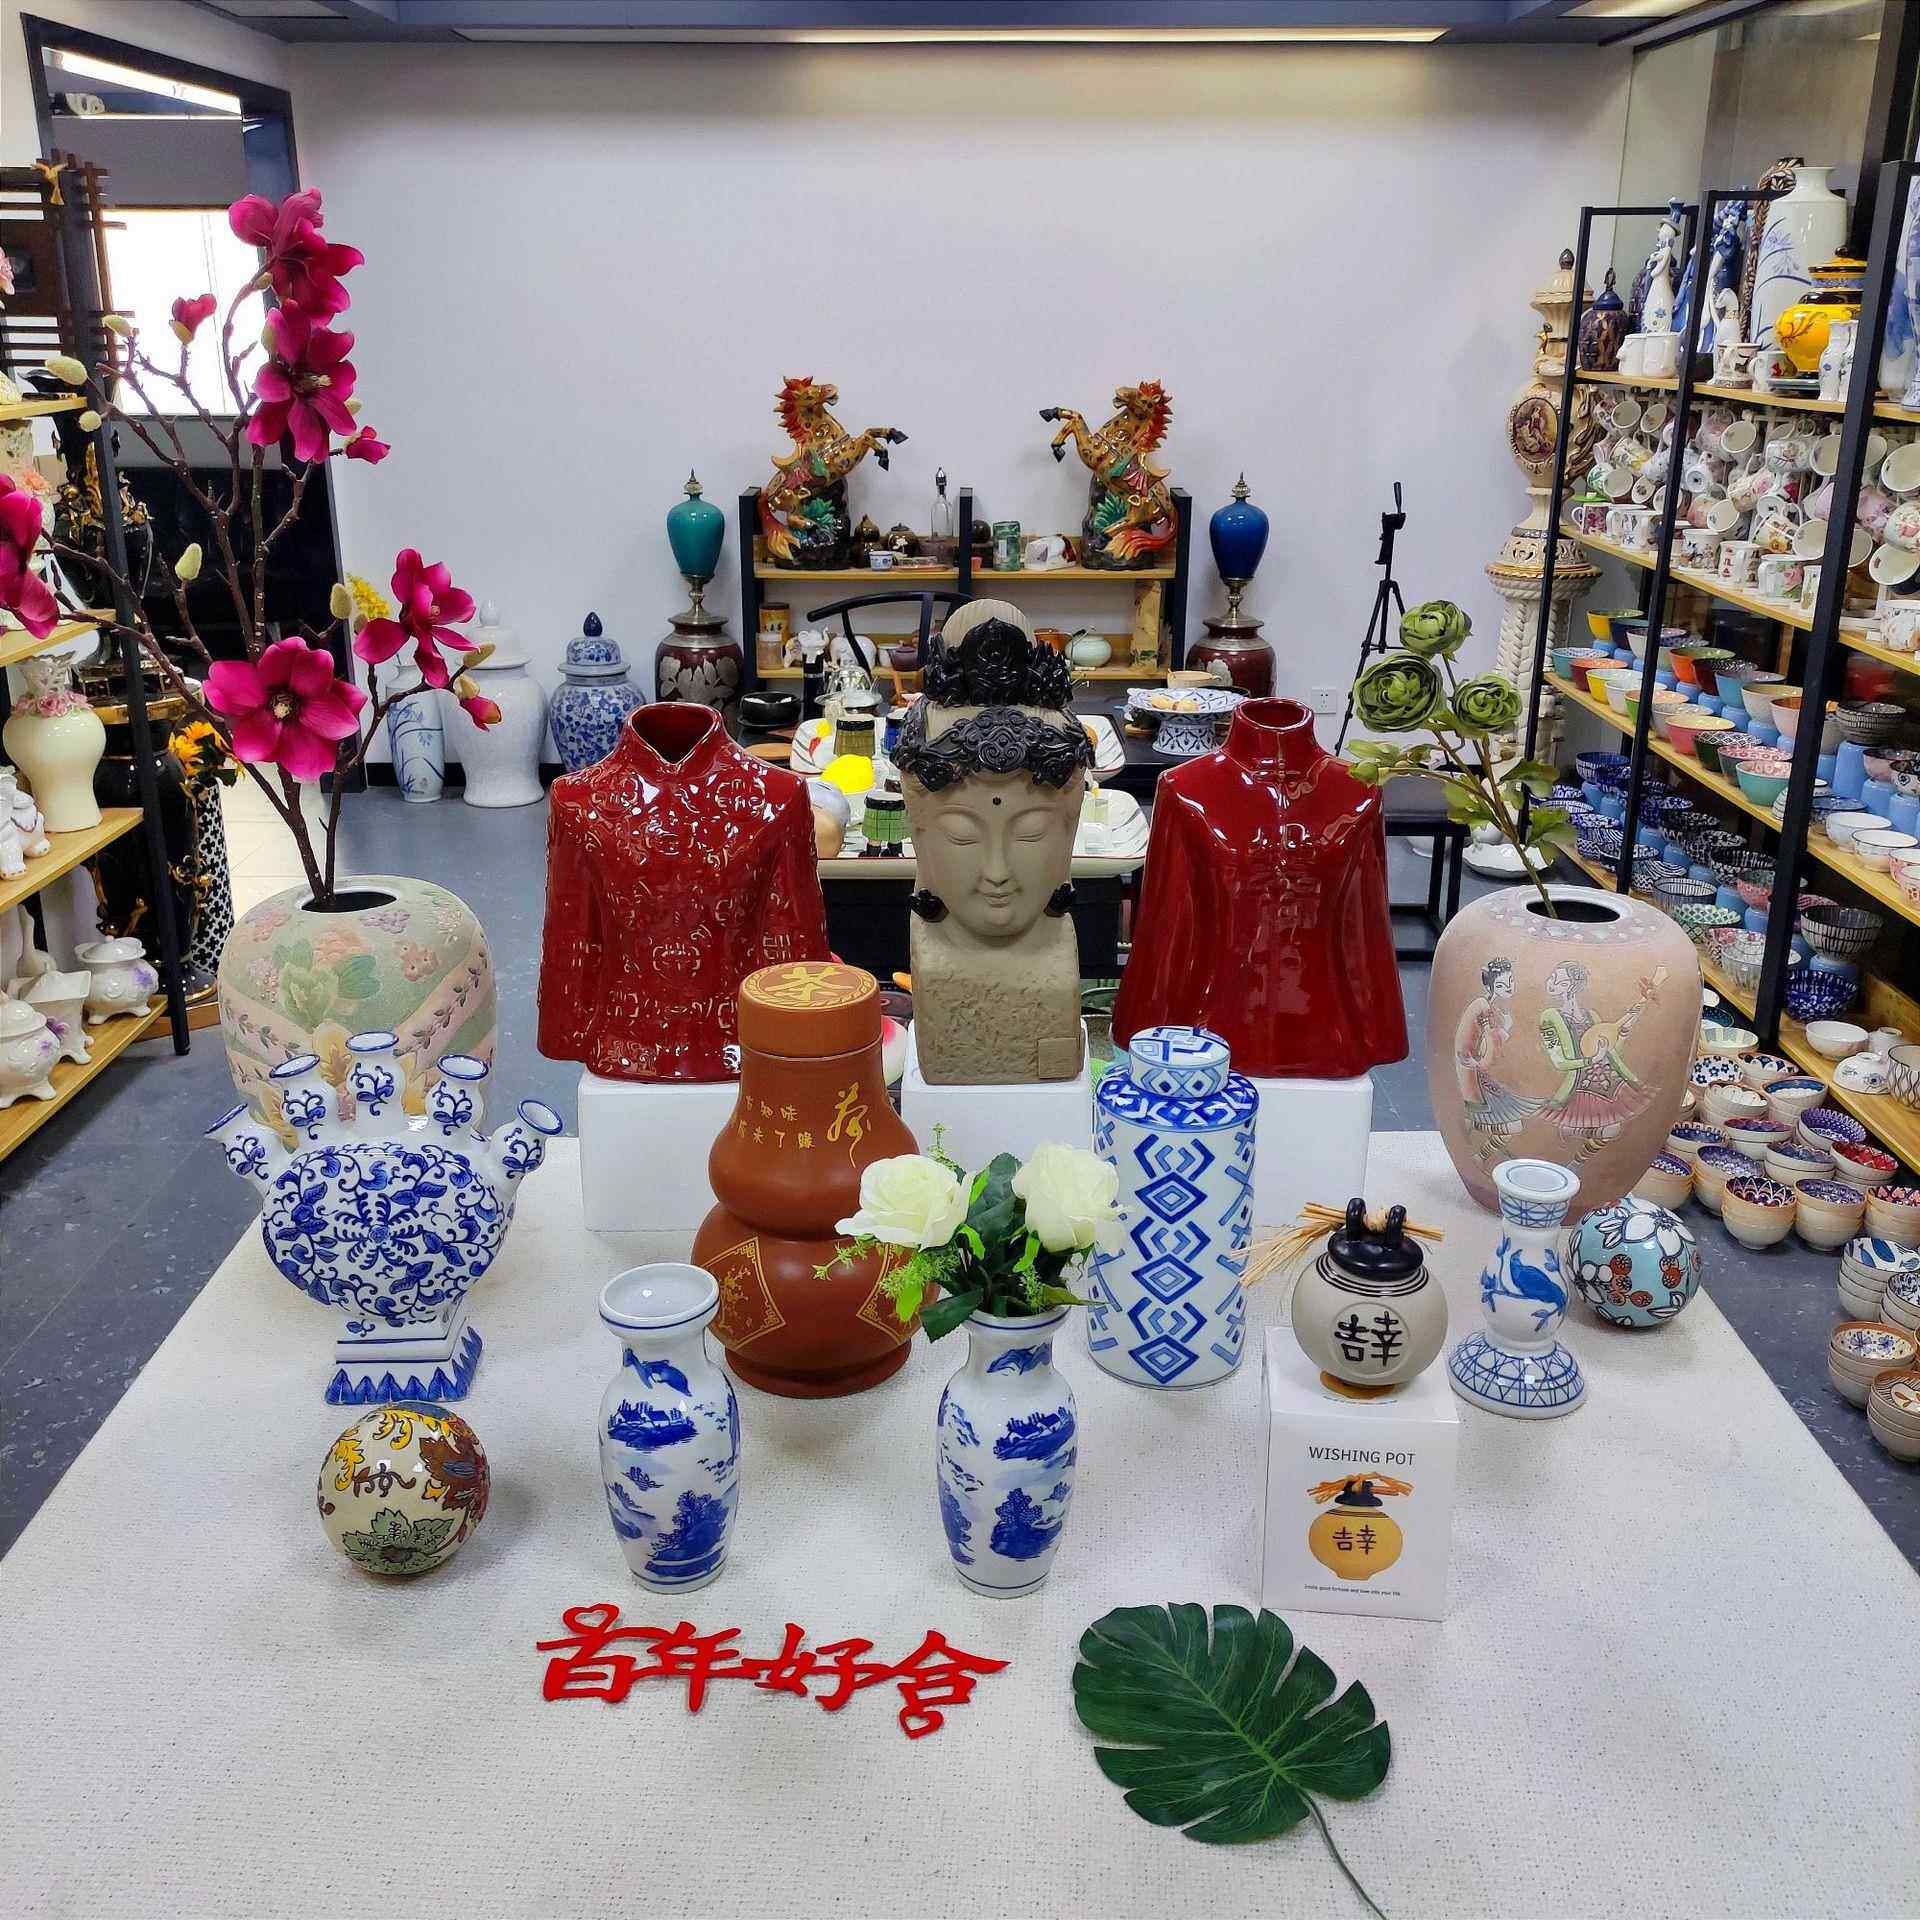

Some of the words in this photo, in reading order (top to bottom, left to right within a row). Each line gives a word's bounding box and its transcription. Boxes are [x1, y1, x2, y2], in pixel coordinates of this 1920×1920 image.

[1309, 1446, 1380, 1464] WISHING
[1385, 1452, 1416, 1465] POT
[537, 1603, 1010, 1739] 百年好合
